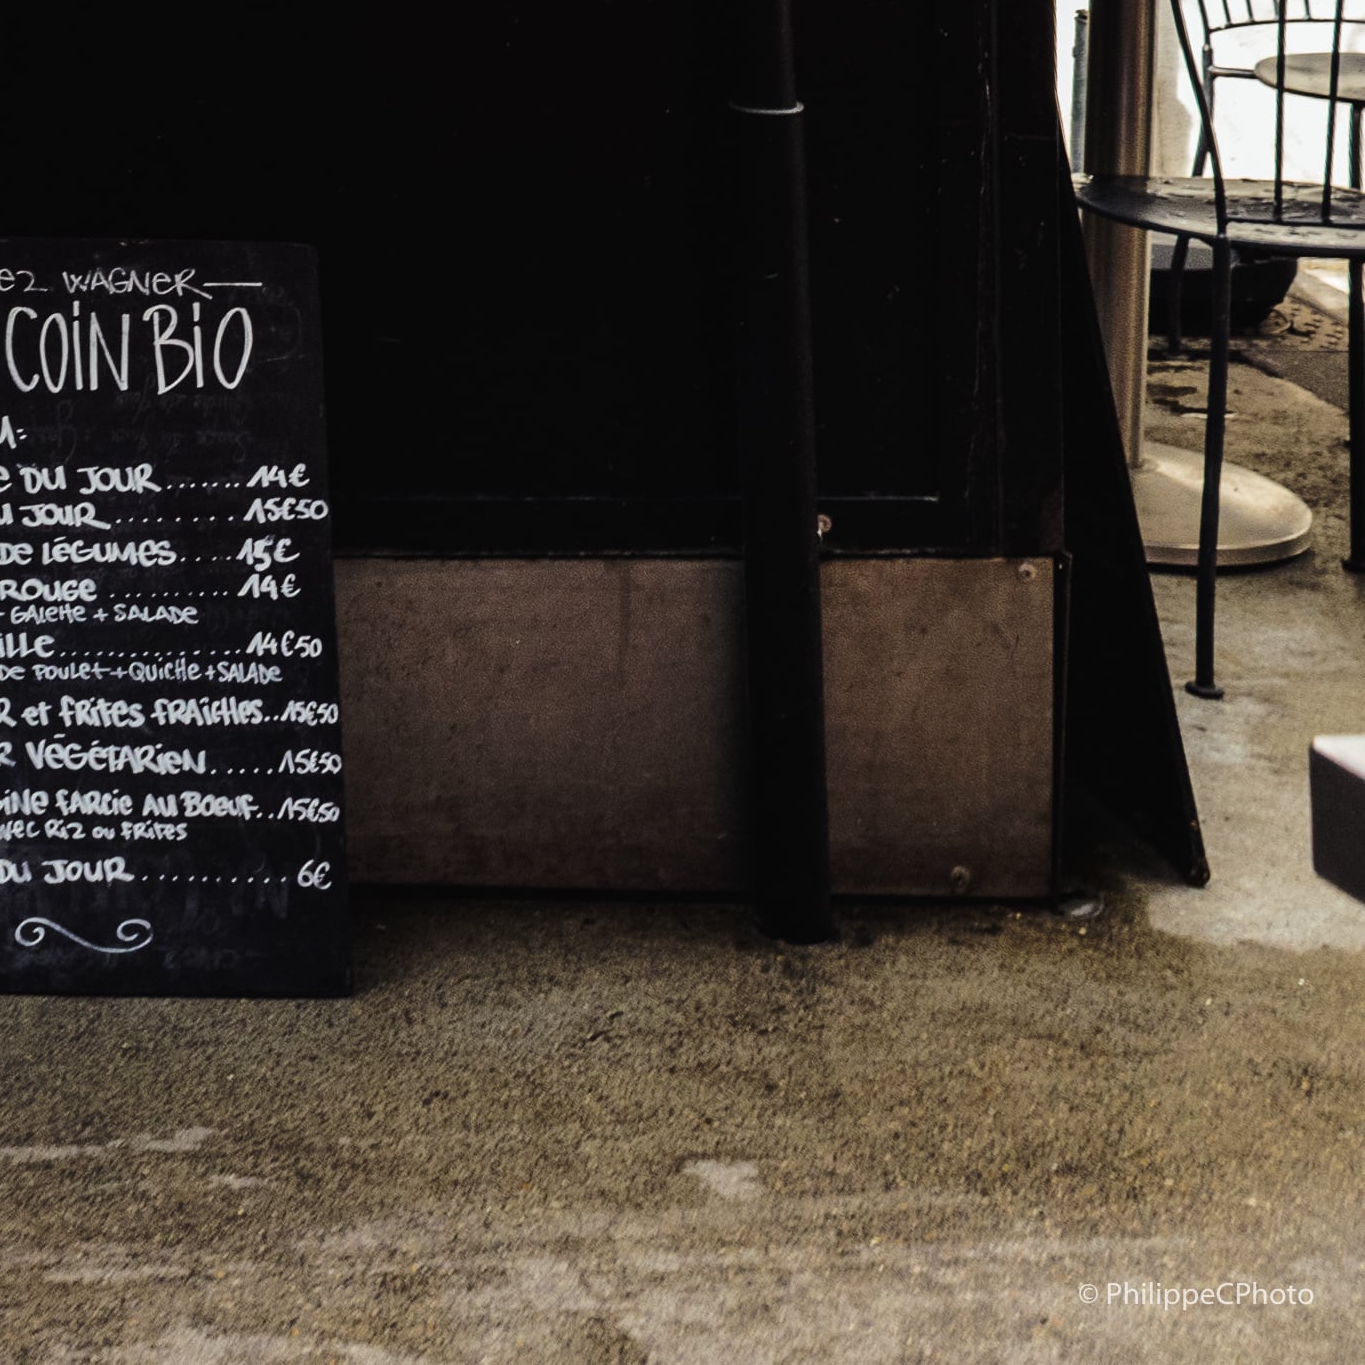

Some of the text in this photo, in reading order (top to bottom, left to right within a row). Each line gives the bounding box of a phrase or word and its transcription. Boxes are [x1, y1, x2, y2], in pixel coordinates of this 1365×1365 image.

[18, 464, 68, 494] DU
[76, 462, 163, 494] JOUR
[245, 463, 311, 489] 14€
[19, 501, 112, 530] JOUR
[242, 496, 330, 524] 15€50
[236, 573, 302, 600] 14€
[245, 630, 323, 658] 14€50
[142, 794, 180, 818] AU
[41, 856, 136, 884] JOUR
[297, 859, 333, 890] 6€
